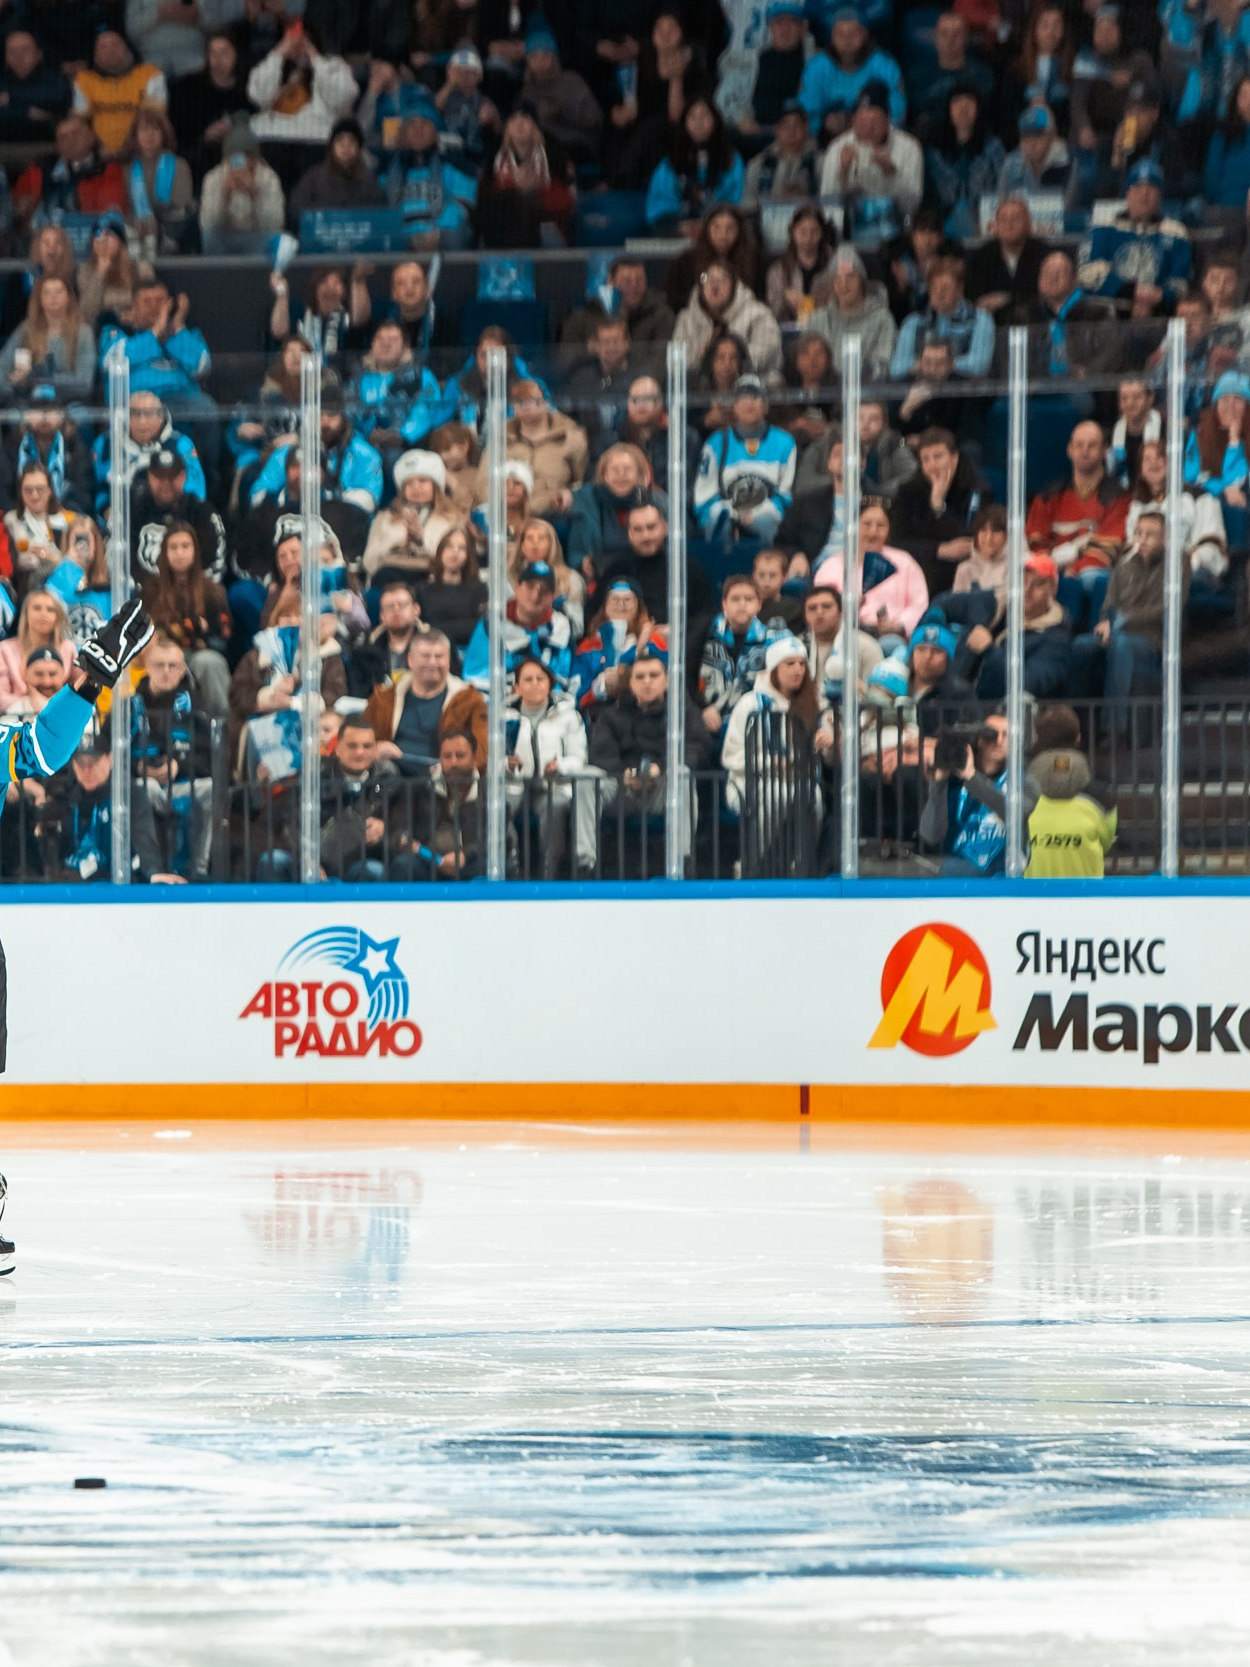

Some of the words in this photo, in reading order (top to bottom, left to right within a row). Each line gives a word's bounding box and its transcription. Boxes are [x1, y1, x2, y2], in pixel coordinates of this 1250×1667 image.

[1014, 929, 1166, 982] Яндекс
[238, 980, 359, 1018] АВТО
[274, 1019, 424, 1059] РАДИО
[1011, 990, 1250, 1066] Марк
